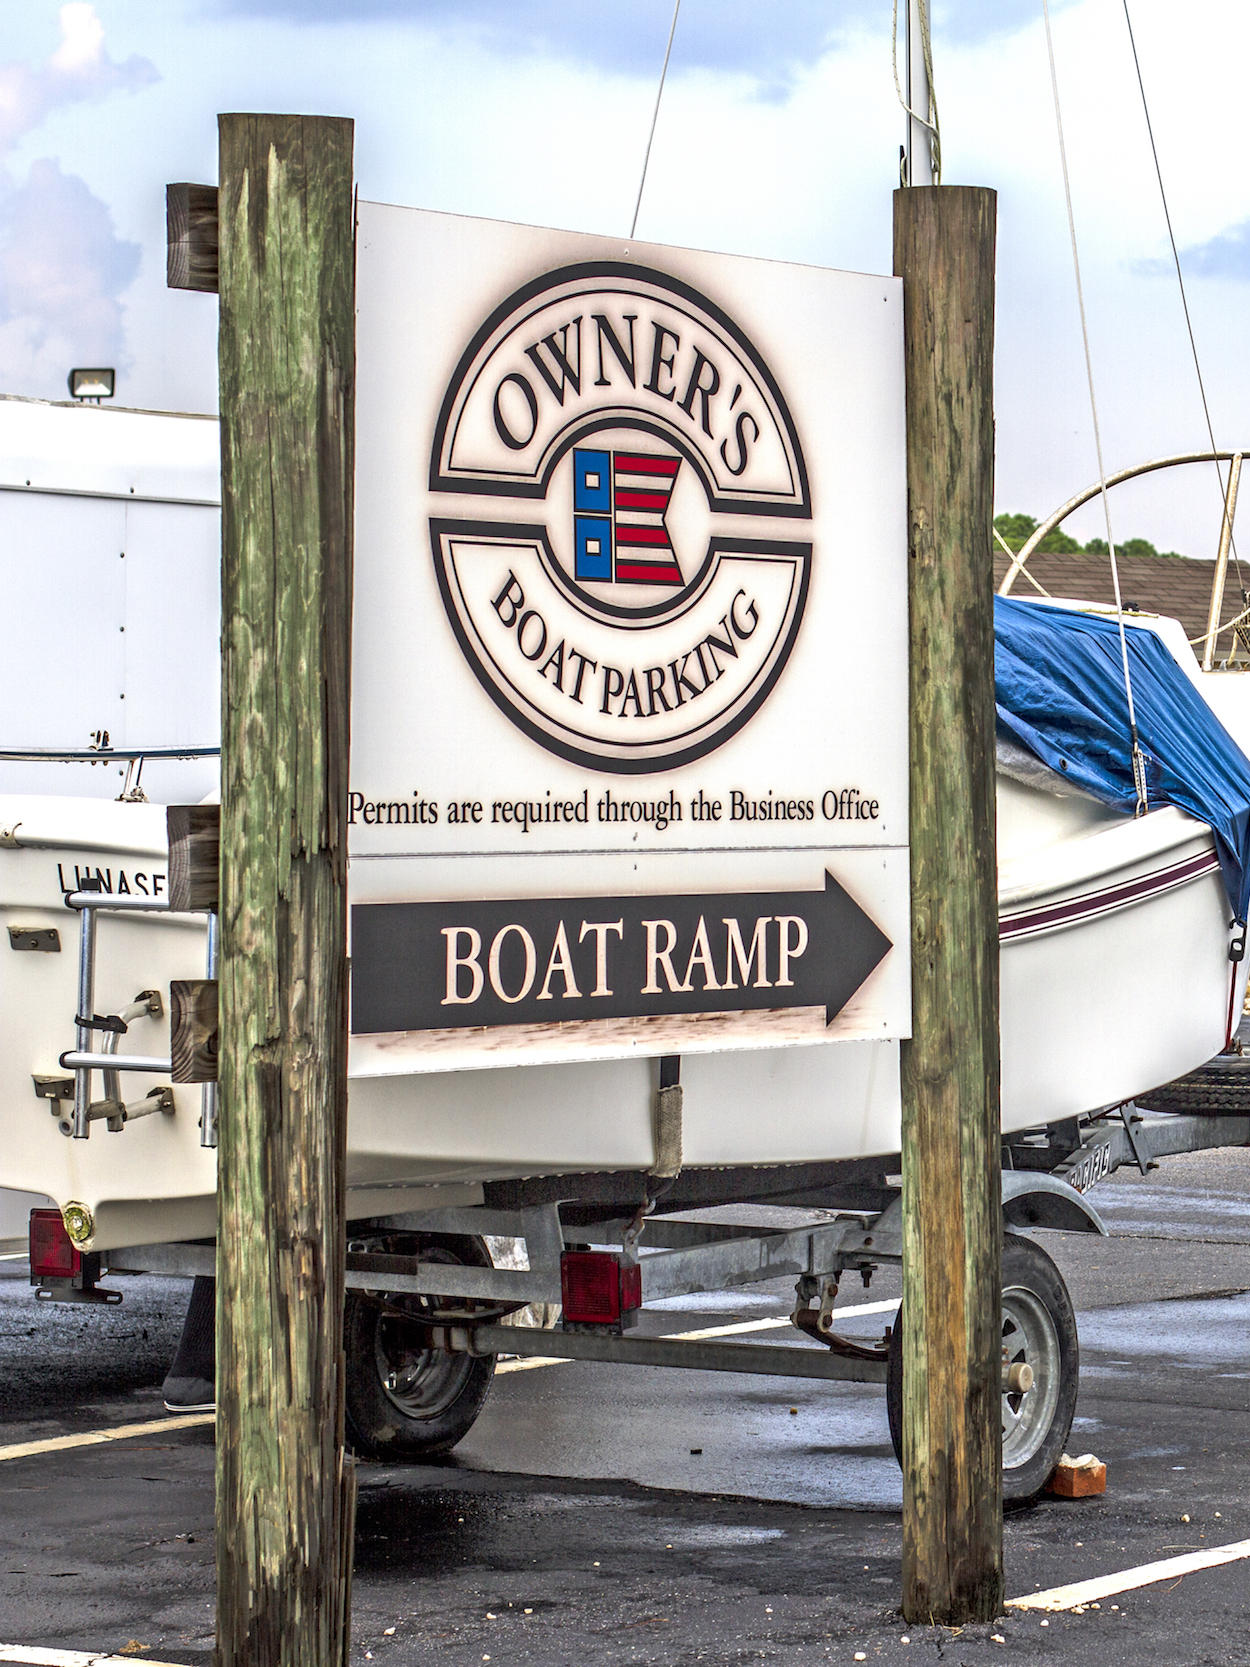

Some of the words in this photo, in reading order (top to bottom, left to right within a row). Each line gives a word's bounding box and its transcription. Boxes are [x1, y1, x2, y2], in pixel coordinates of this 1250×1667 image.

[493, 315, 759, 476] OWNER'S
[491, 569, 598, 702] BOAT
[600, 589, 760, 718] PARKING
[347, 790, 438, 825] Permits
[447, 800, 483, 824] are
[491, 791, 589, 833] required
[597, 791, 682, 830] through
[691, 791, 722, 822] the
[730, 791, 814, 821] Business
[822, 790, 879, 820] Office
[441, 918, 624, 1006] BOAT
[641, 914, 809, 995] RAMP
